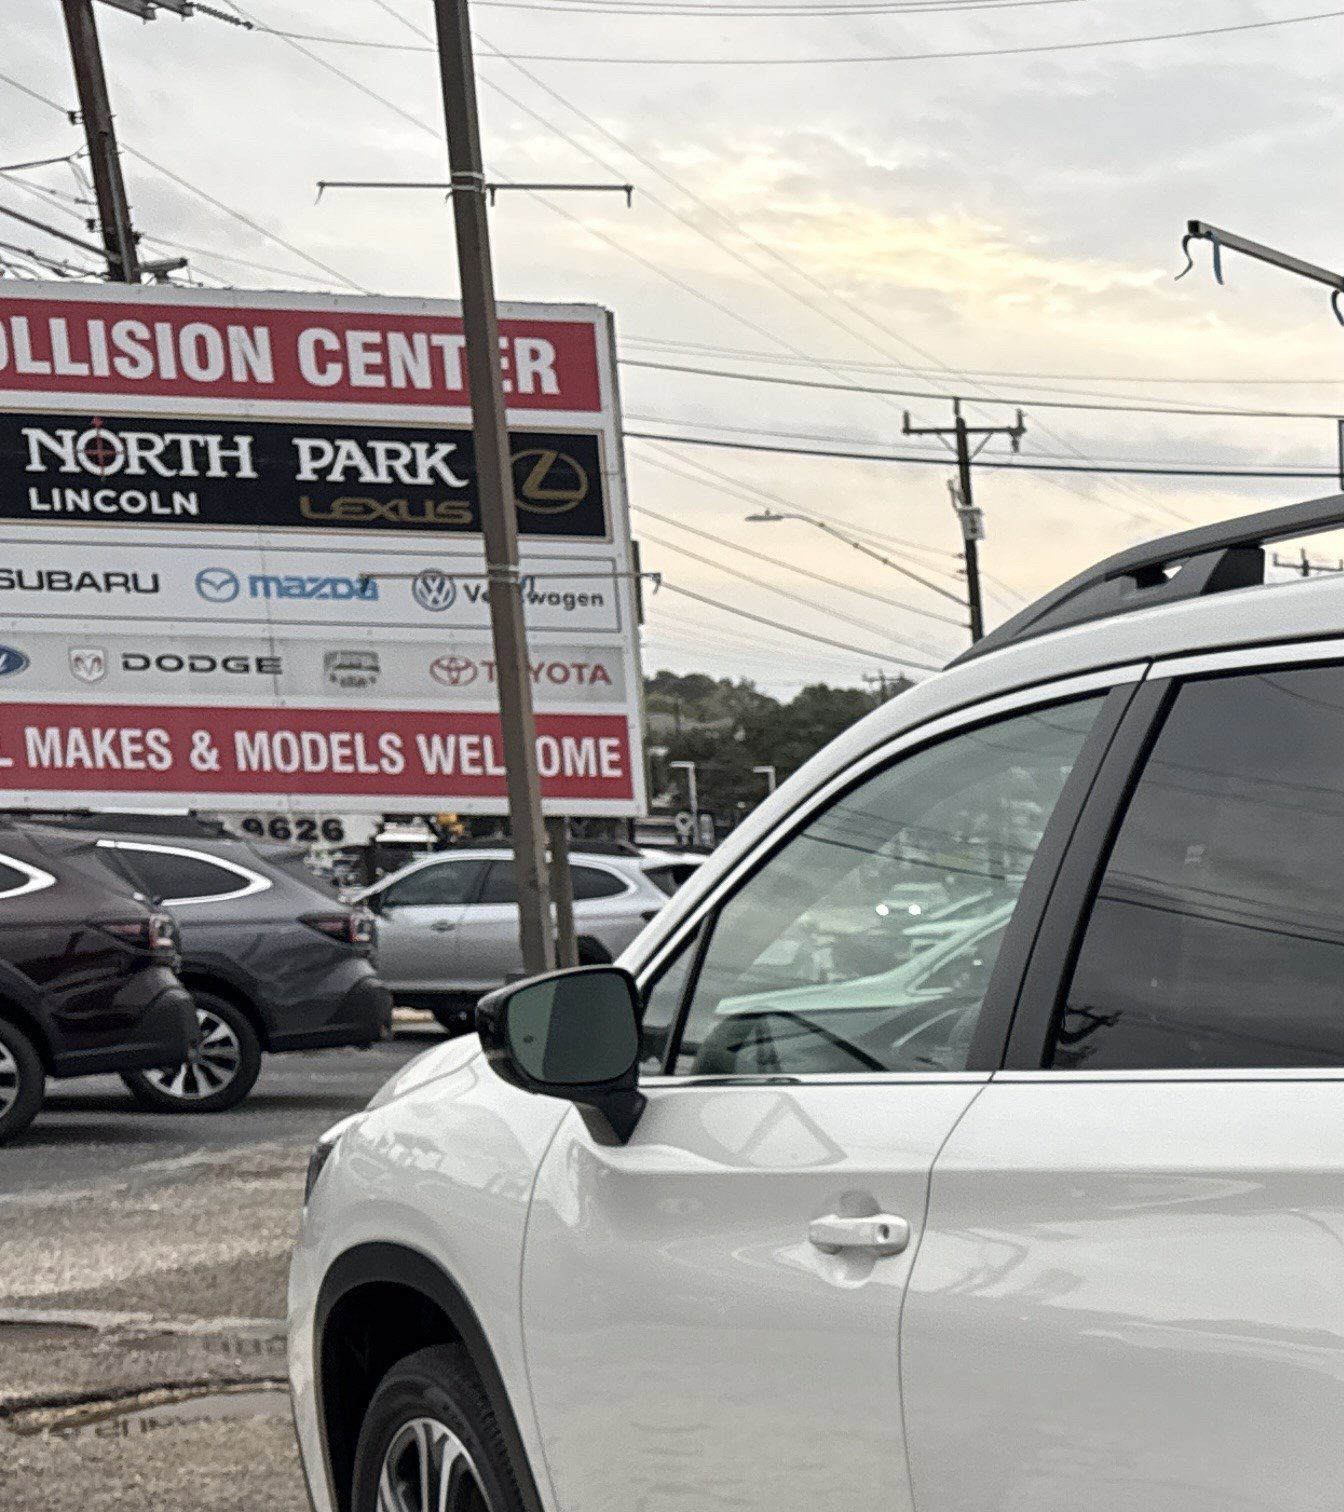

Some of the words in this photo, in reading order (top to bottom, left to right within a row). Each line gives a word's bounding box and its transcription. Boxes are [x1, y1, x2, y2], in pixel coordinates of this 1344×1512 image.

[0, 316, 275, 384] LLISION
[21, 427, 258, 478] NORTH
[292, 438, 469, 488] PARK
[28, 486, 200, 516] LINCOLN
[299, 496, 473, 525] LEXUS
[121, 652, 284, 675] DODGE
[480, 659, 613, 686] TYOTA
[24, 726, 173, 771] MAKES
[189, 729, 221, 772] &
[233, 730, 405, 775] MODELS
[415, 733, 624, 778] WELOME
[241, 817, 344, 842] 9626
